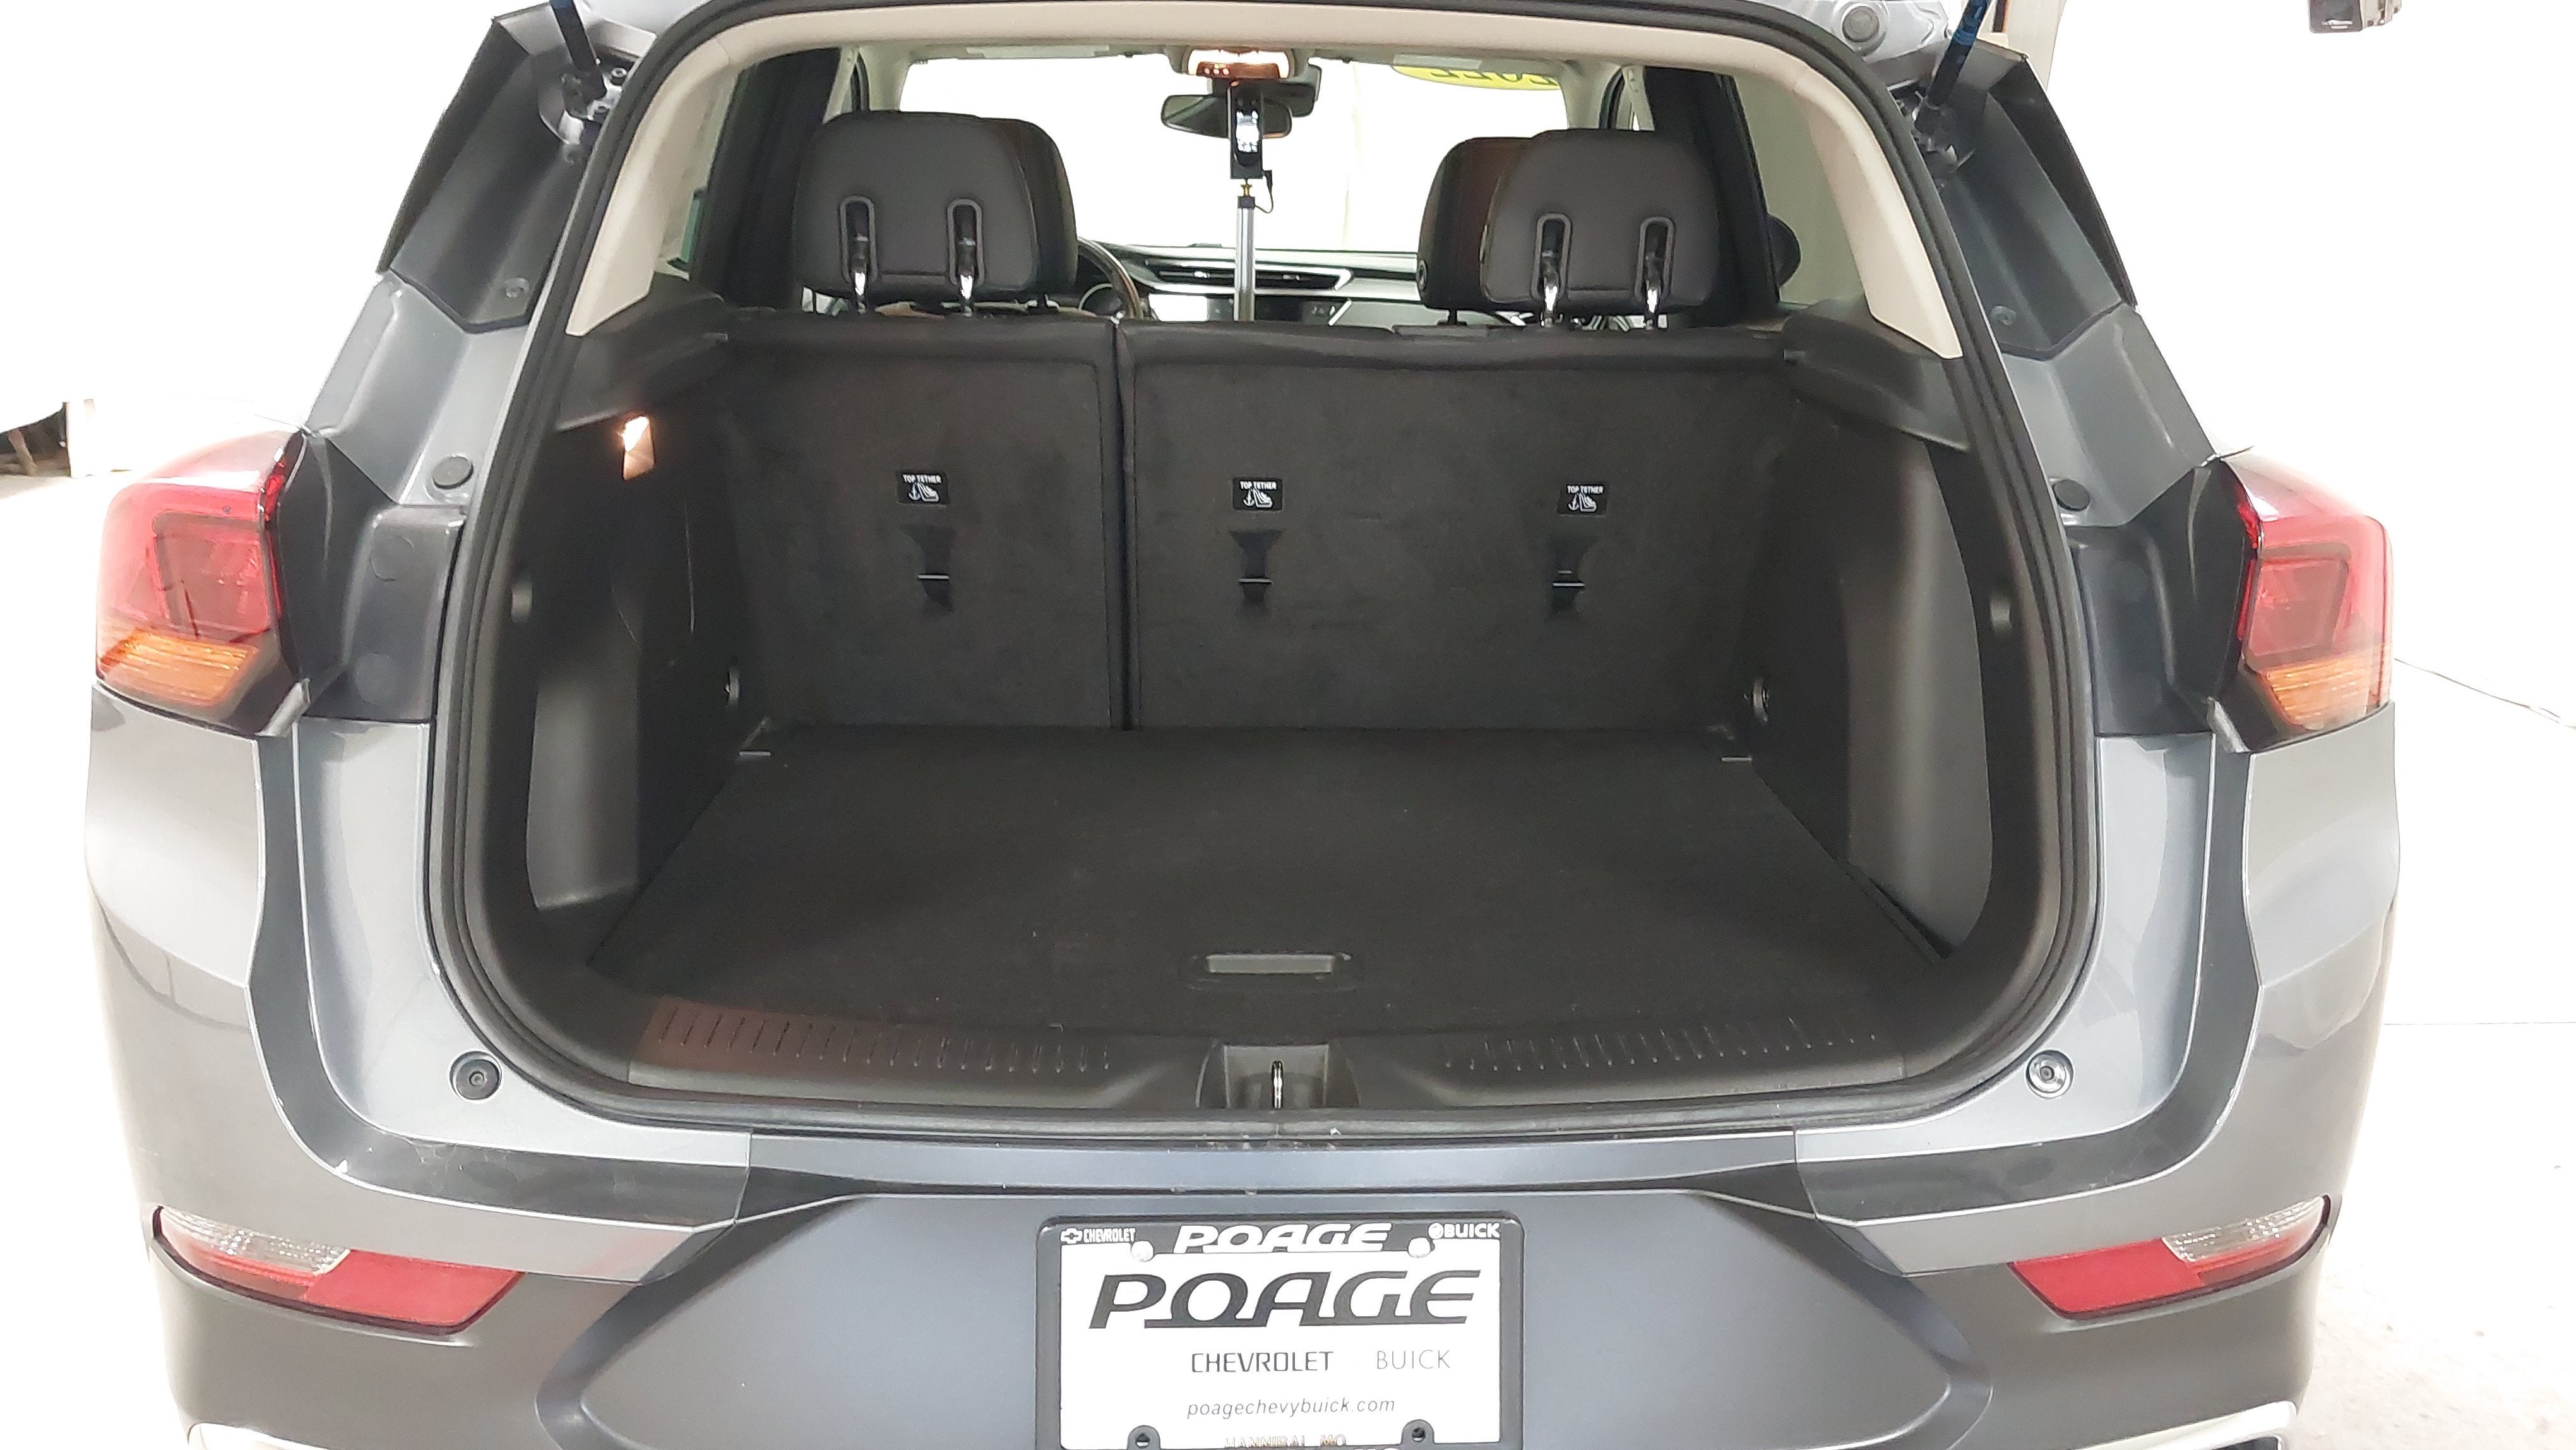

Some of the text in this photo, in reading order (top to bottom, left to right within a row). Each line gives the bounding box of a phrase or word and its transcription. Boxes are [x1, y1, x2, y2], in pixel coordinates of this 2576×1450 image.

[902, 474, 916, 483] TOP
[1239, 481, 1277, 490] TOP TETHER
[1567, 485, 1604, 494] TOP TETHER
[1083, 1228, 1136, 1243] CHEVROLET
[1444, 1222, 1501, 1238] BUICK
[1173, 1223, 1393, 1254] POAGE
[1088, 1269, 1481, 1329] POAGE
[1191, 1349, 1450, 1373] CHEVROLET BUICK
[1186, 1398, 1395, 1420] poagechevybuick.com
